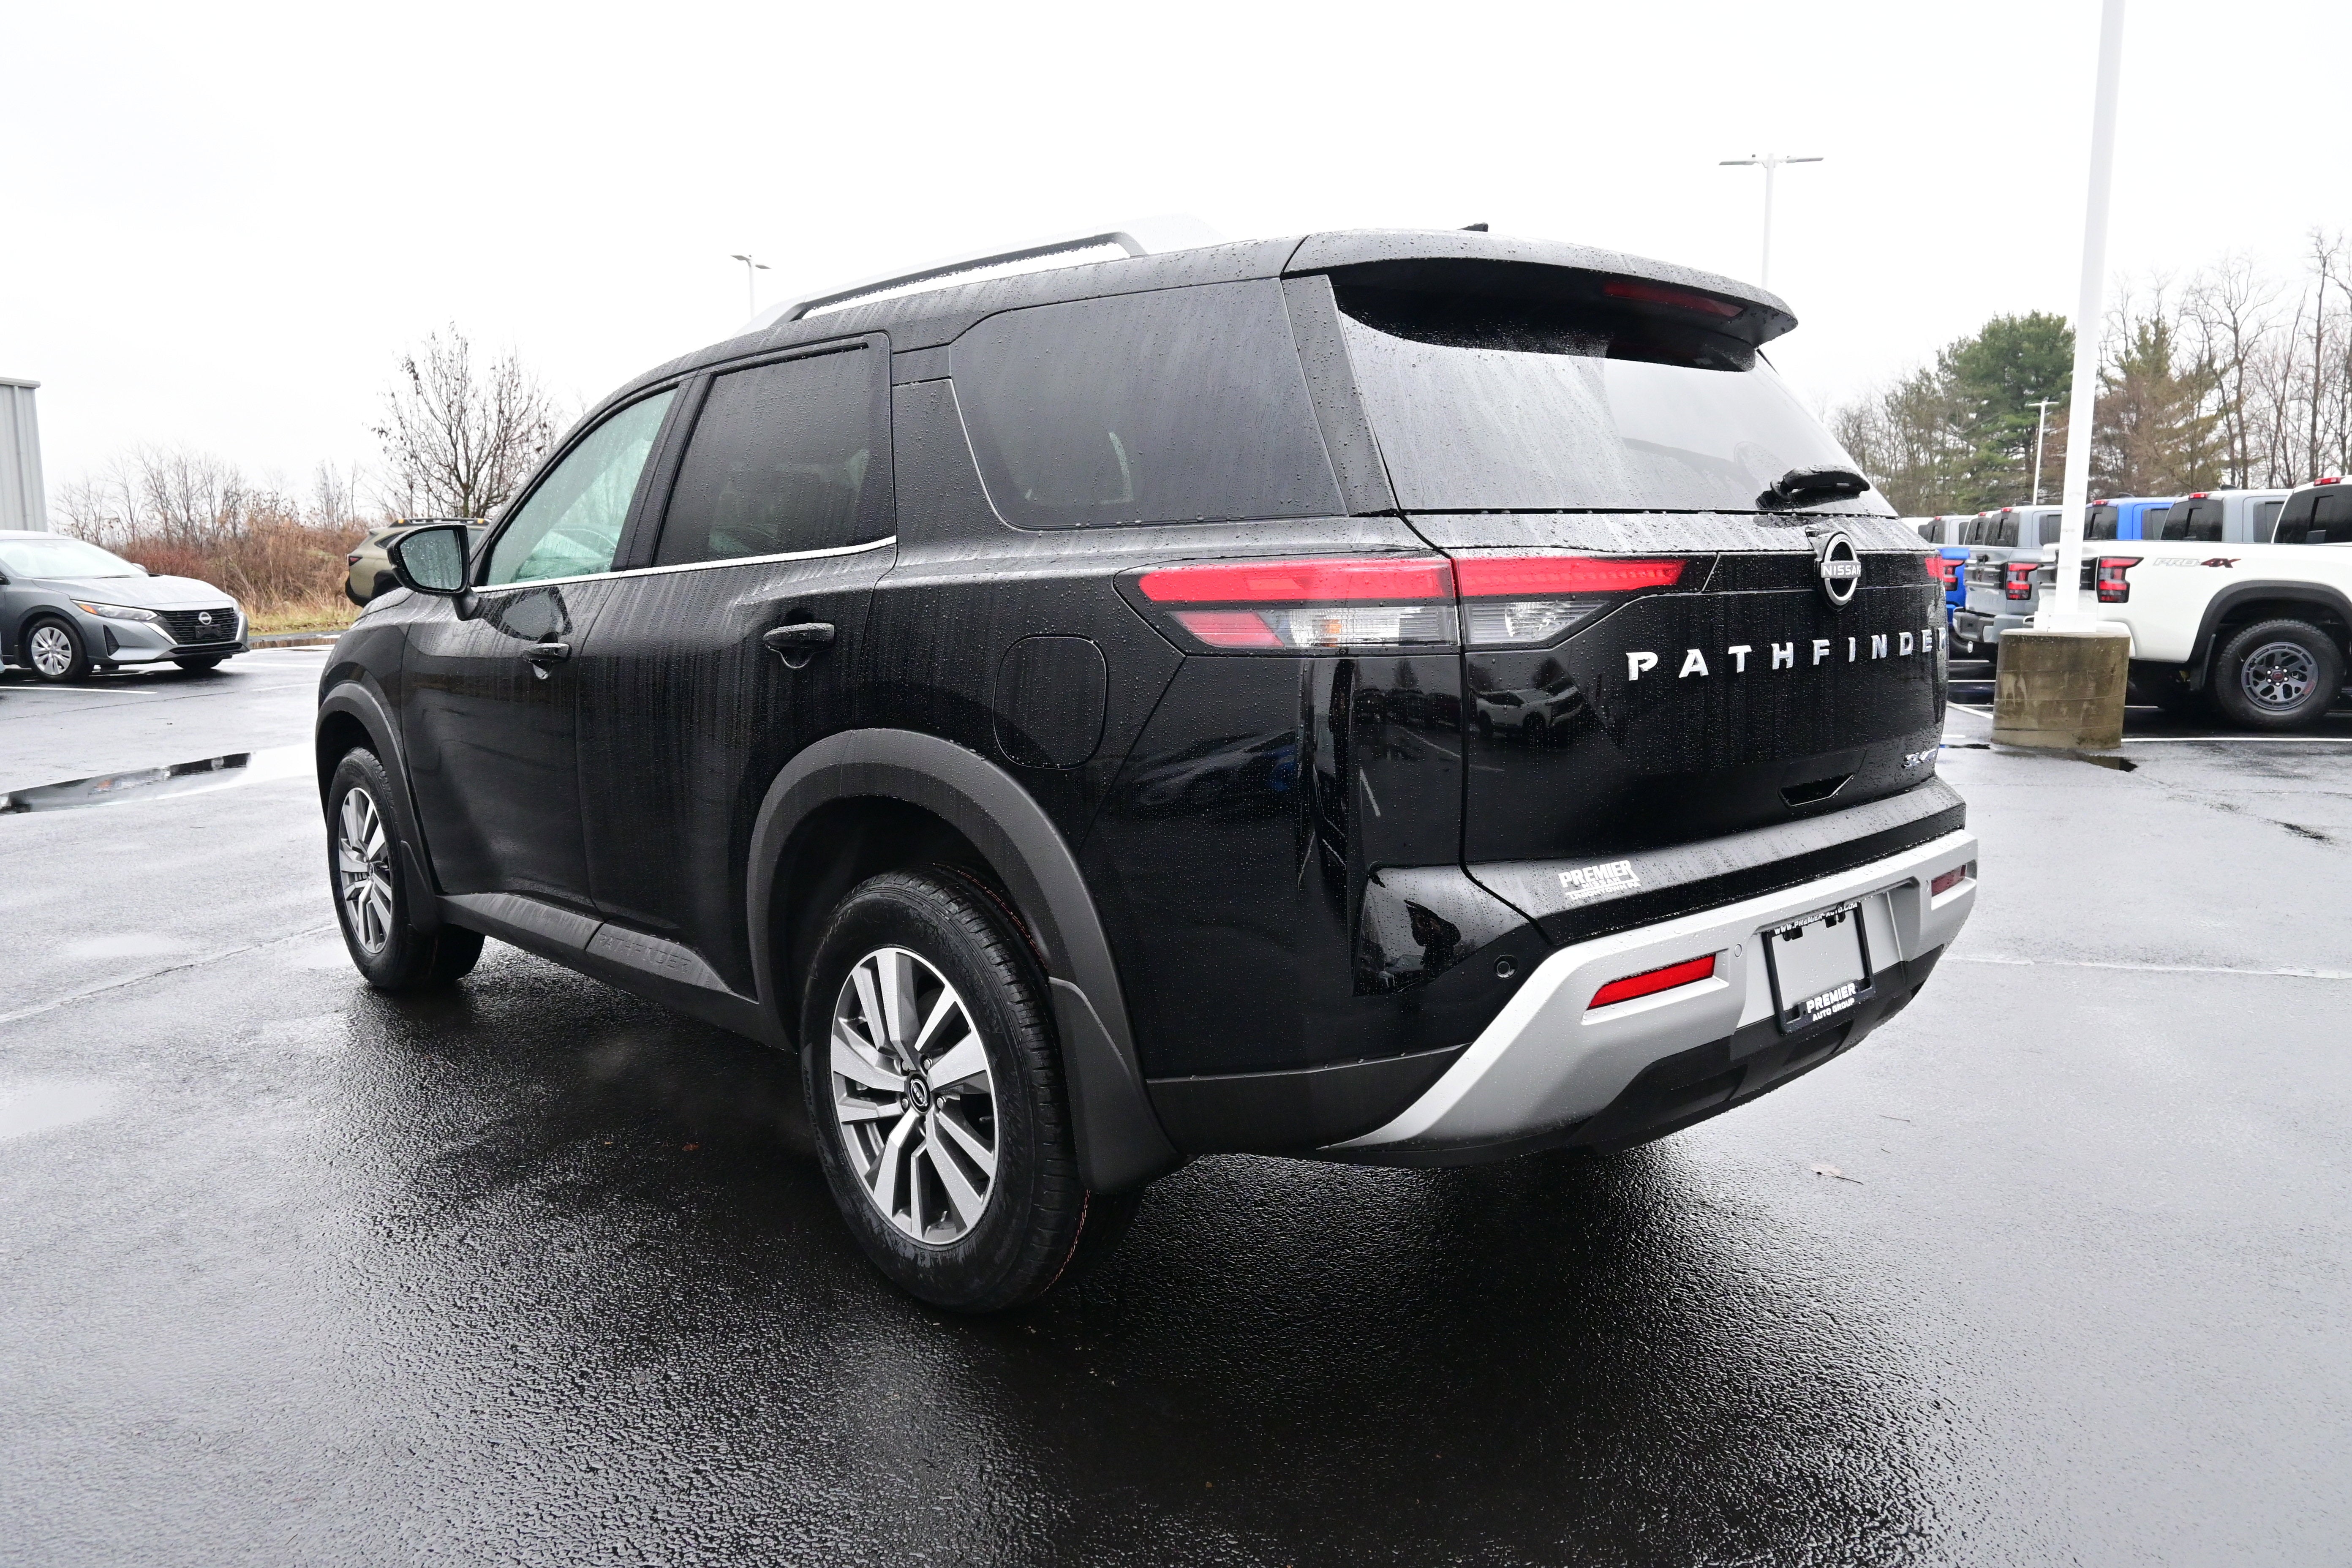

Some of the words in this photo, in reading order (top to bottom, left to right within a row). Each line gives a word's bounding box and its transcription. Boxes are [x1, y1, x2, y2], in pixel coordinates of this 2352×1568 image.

[1823, 564, 1861, 576] NISSAN
[1558, 860, 1635, 887] PREMIER
[1582, 877, 1621, 889] NISSAN
[1570, 883, 1627, 900] UNIONTOWN
[1806, 983, 1856, 1013] PREMIER
[1812, 1008, 1832, 1022] AUTO
[1832, 997, 1855, 1013] GROUP
